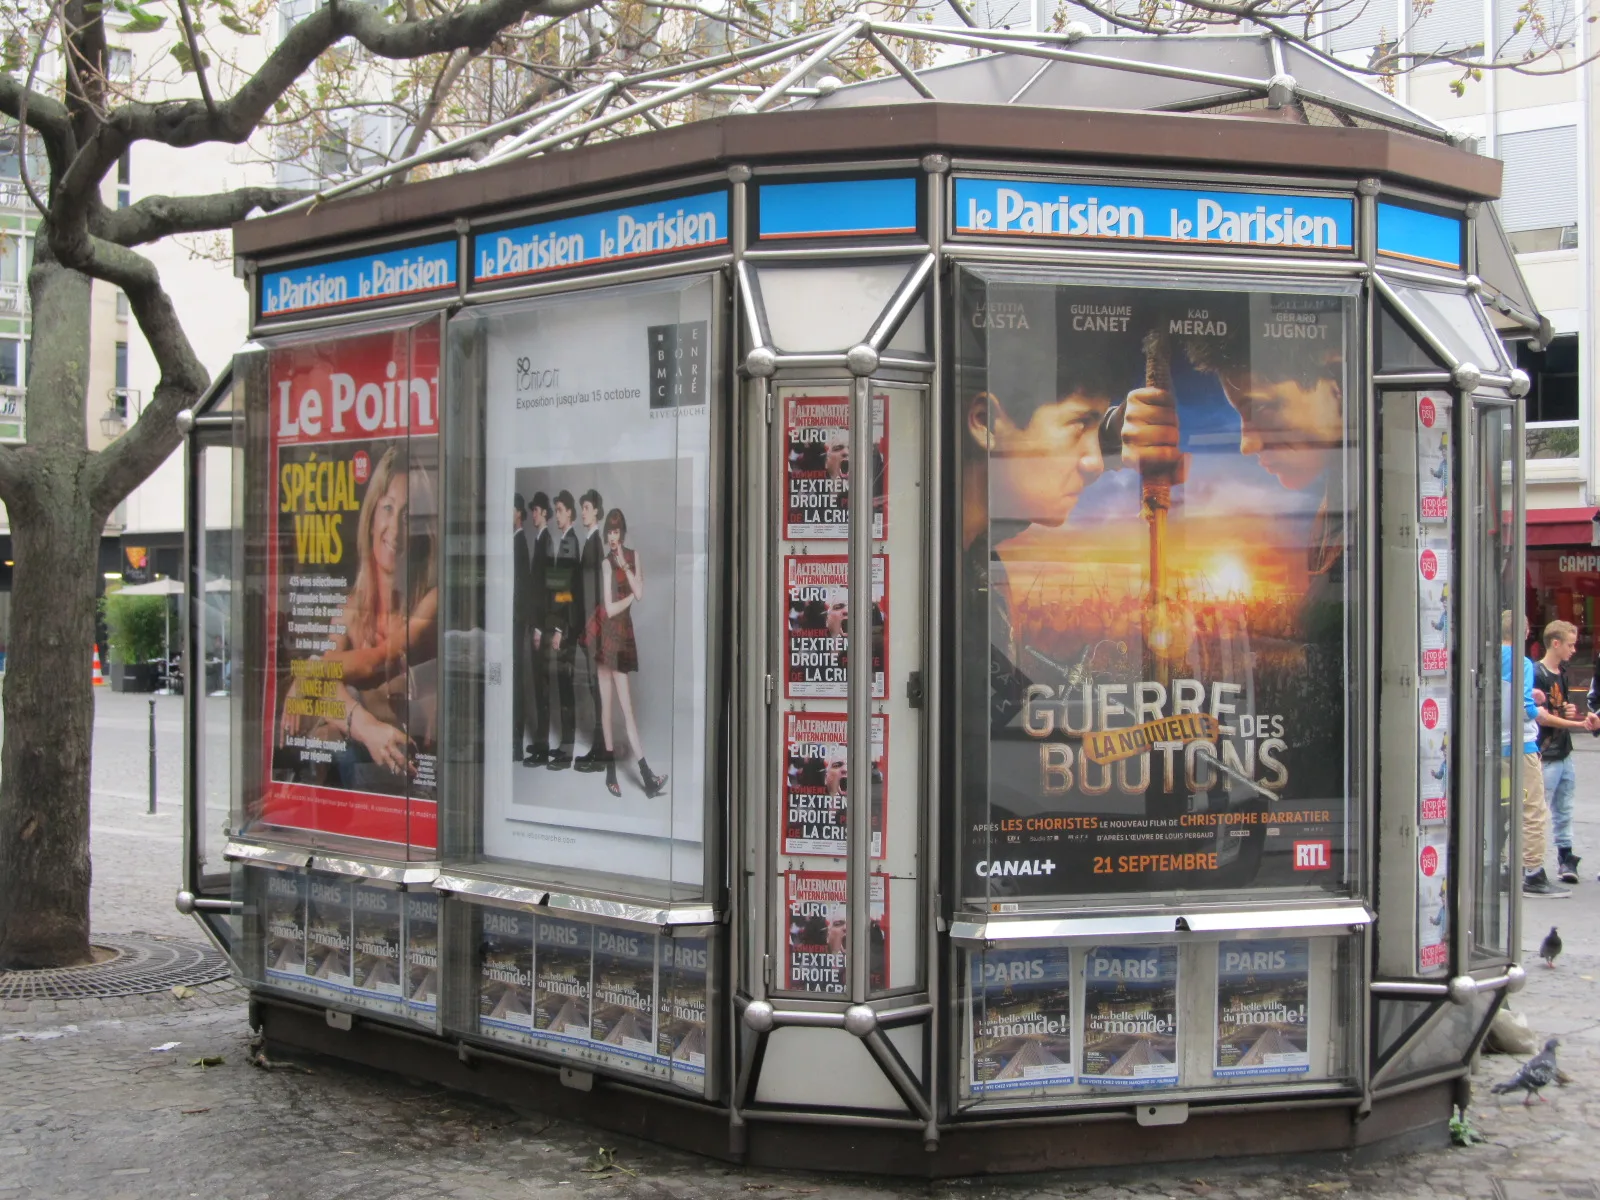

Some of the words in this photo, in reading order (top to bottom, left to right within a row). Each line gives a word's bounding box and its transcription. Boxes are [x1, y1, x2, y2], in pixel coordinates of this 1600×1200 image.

[969, 199, 991, 230] le
[997, 188, 1144, 238] Parisien
[1171, 209, 1192, 240] le
[1198, 199, 1337, 247] Parisien
[482, 250, 495, 277] le
[497, 232, 584, 275] Parisien
[601, 229, 614, 258] le
[618, 210, 716, 256] Parisien
[268, 288, 278, 312] le
[280, 274, 347, 310] Parisien
[360, 273, 370, 298] le
[373, 256, 448, 295] Parisien
[1070, 304, 1132, 315] GUILLAUME
[1188, 308, 1208, 319] KAD
[972, 314, 1029, 329] CASTA
[1072, 316, 1130, 332] CANET
[1169, 320, 1227, 336] MERAD
[1263, 324, 1328, 340] JUGNOT
[516, 396, 555, 410] Exposition
[556, 391, 590, 407] jusqu'au
[591, 391, 602, 401] 15
[604, 387, 641, 400] octobre
[277, 380, 322, 436] Le
[672, 407, 706, 417] GAUCHE
[281, 452, 359, 512] SPÉCIAL
[791, 494, 837, 508] DROITE
[1422, 497, 1436, 508] Trop
[804, 510, 821, 523] LA
[1423, 507, 1436, 517] chez
[1438, 507, 1442, 516] le
[295, 514, 342, 564] VINS
[792, 653, 838, 666] DROITE
[1423, 650, 1436, 662] Trop
[1423, 659, 1437, 669] chez
[1439, 659, 1443, 668] le
[806, 668, 822, 681] LA
[826, 668, 847, 681] CRI
[1022, 680, 1241, 738] GUERRE
[1240, 714, 1284, 738] DES
[1091, 736, 1116, 758] LA
[1119, 716, 1214, 750] NOUVELLE
[1040, 738, 1289, 795] BOUTONS
[1422, 801, 1436, 812] Trop
[1422, 809, 1437, 819] chez
[1438, 808, 1443, 818] le
[790, 810, 836, 824] DROITE
[973, 823, 999, 832] APRÈS
[1001, 819, 1023, 831] LES
[1027, 817, 1098, 831] CHORISTES
[1110, 820, 1148, 828] NOUVEAU
[1180, 813, 1257, 826] CHRISTOPHE
[1261, 810, 1330, 823] BARRATIER
[803, 825, 819, 839] LA
[1093, 856, 1113, 873] 21
[1118, 853, 1218, 873] SEPTEMBRE
[1296, 844, 1326, 866] RTL
[976, 859, 1056, 876] CANAL+
[269, 877, 297, 894] PARIS
[312, 883, 341, 902] PARIS
[356, 891, 387, 910] PARIS
[483, 913, 518, 935] PARIS
[540, 923, 578, 945] PARIS
[362, 942, 399, 958] monde!
[600, 932, 638, 956] PARIS
[664, 944, 707, 968] PARIS
[1226, 950, 1286, 972] PARIS
[490, 969, 530, 986] monde!
[792, 968, 839, 982] DROITE
[979, 959, 1044, 982] PARIS
[1094, 959, 1158, 979] PARIS
[539, 980, 546, 988] du
[547, 980, 590, 998] monde!
[596, 990, 604, 998] du
[604, 991, 650, 1011] monde!
[1240, 1002, 1260, 1011] belle
[1262, 1001, 1282, 1010] ville
[998, 1014, 1020, 1024] belle
[1021, 1012, 1042, 1021] ville
[1110, 1010, 1133, 1020] belle
[1134, 1011, 1153, 1020] ville
[1224, 1013, 1234, 1022] du
[1236, 1004, 1304, 1025] monde!
[993, 1014, 1066, 1037] monde!
[1090, 1020, 1103, 1029] du
[1104, 1014, 1172, 1034] monde!
